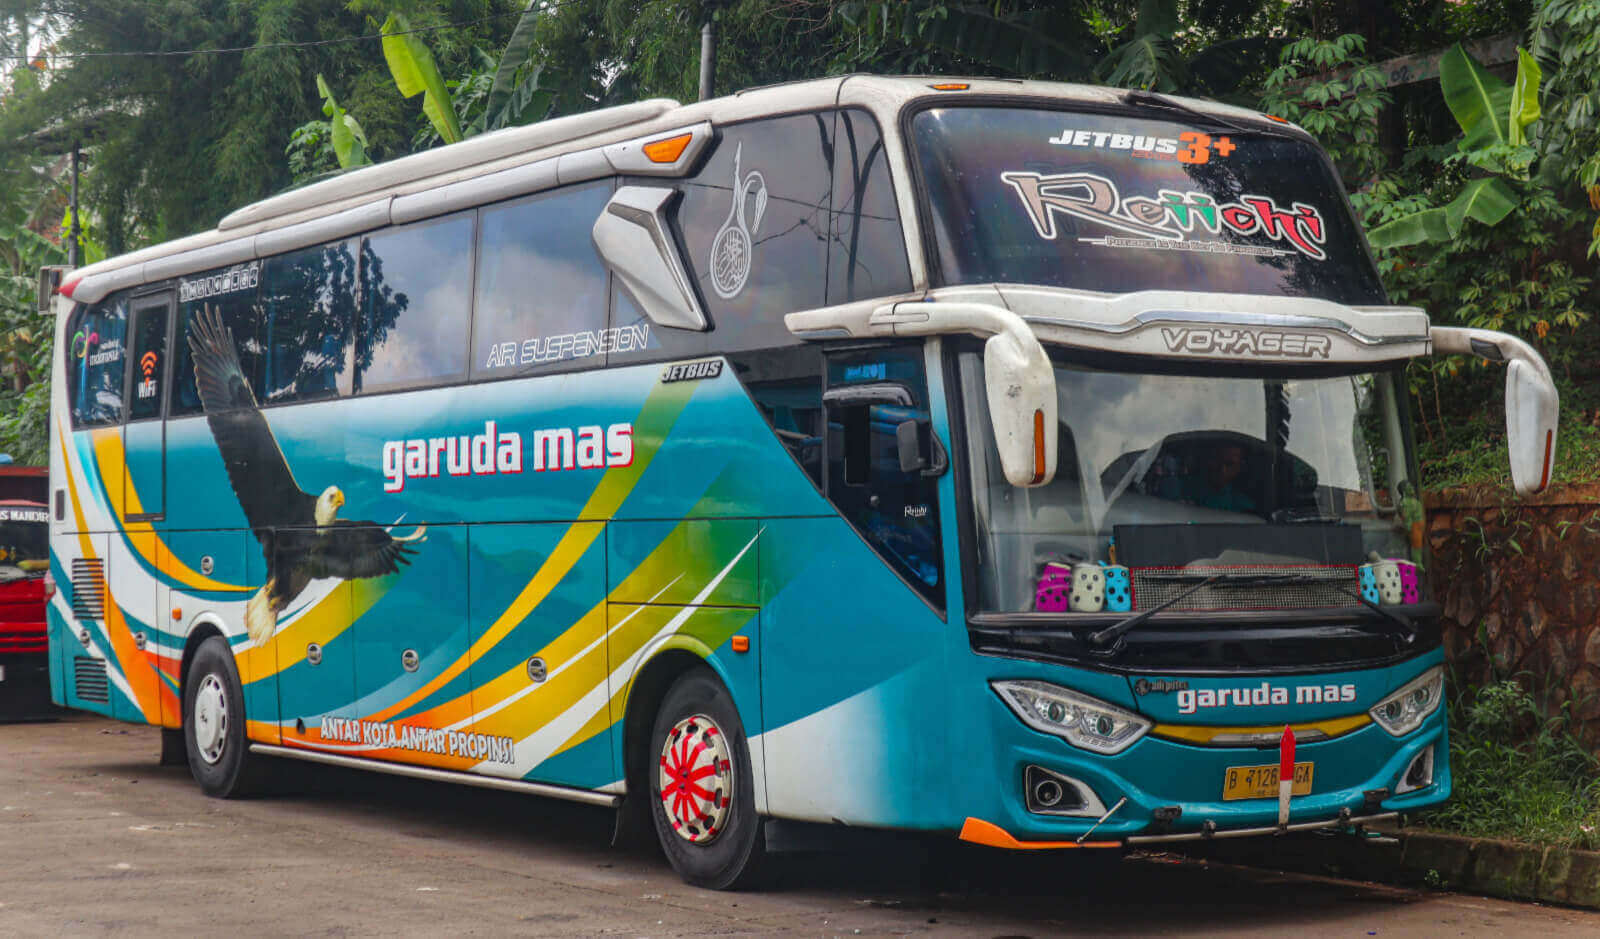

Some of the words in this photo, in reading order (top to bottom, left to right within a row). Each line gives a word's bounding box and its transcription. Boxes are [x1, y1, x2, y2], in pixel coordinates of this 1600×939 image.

[486, 342, 516, 368] AIR
[521, 324, 648, 364] SUSPENSION
[1161, 328, 1332, 358] VOYAGER
[661, 361, 722, 384] JETBUS
[382, 420, 523, 493] garuda
[533, 423, 634, 472] mas
[1177, 682, 1288, 714] garuda
[1295, 684, 1356, 704] mas
[320, 715, 361, 743] ANTAR
[449, 730, 515, 763] PROPINSI
[1229, 770, 1238, 790] B
